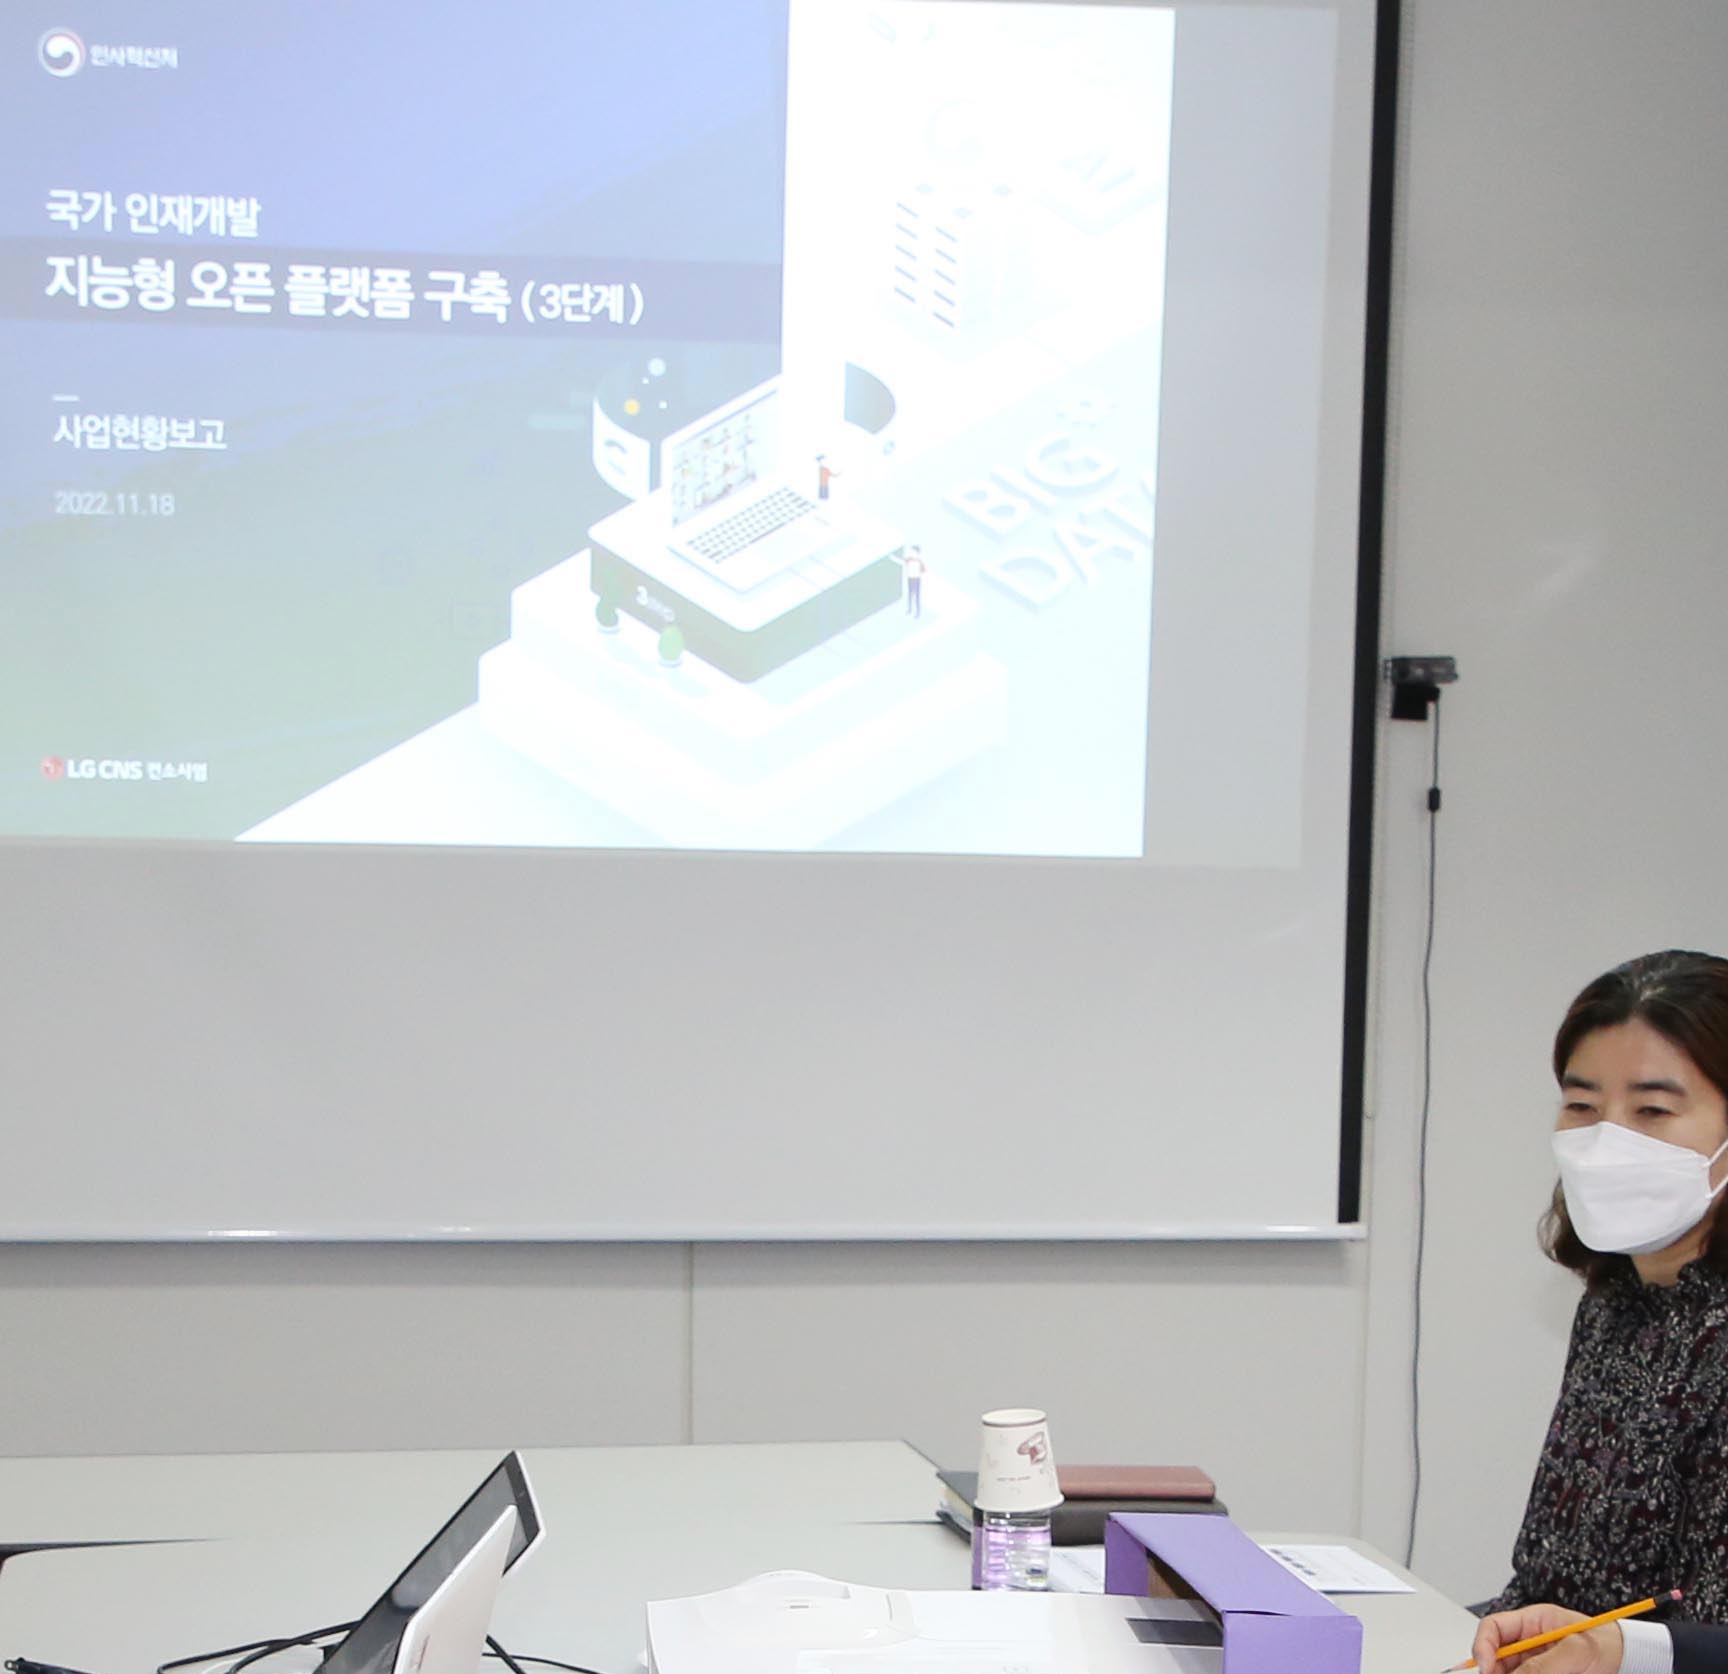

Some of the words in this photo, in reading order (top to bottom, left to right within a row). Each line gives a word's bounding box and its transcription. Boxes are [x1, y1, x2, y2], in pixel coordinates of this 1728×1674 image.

[46, 188, 115, 232] 국가
[125, 193, 261, 237] 인재개발
[44, 255, 175, 312] 지능형
[186, 260, 274, 314] 오픈
[285, 264, 414, 319] 플랫폼
[424, 271, 511, 323] 구축
[53, 415, 227, 451] 사업현황보고
[56, 490, 174, 517] 2022.11.18
[67, 759, 95, 779] LG
[98, 760, 142, 781] CNS
